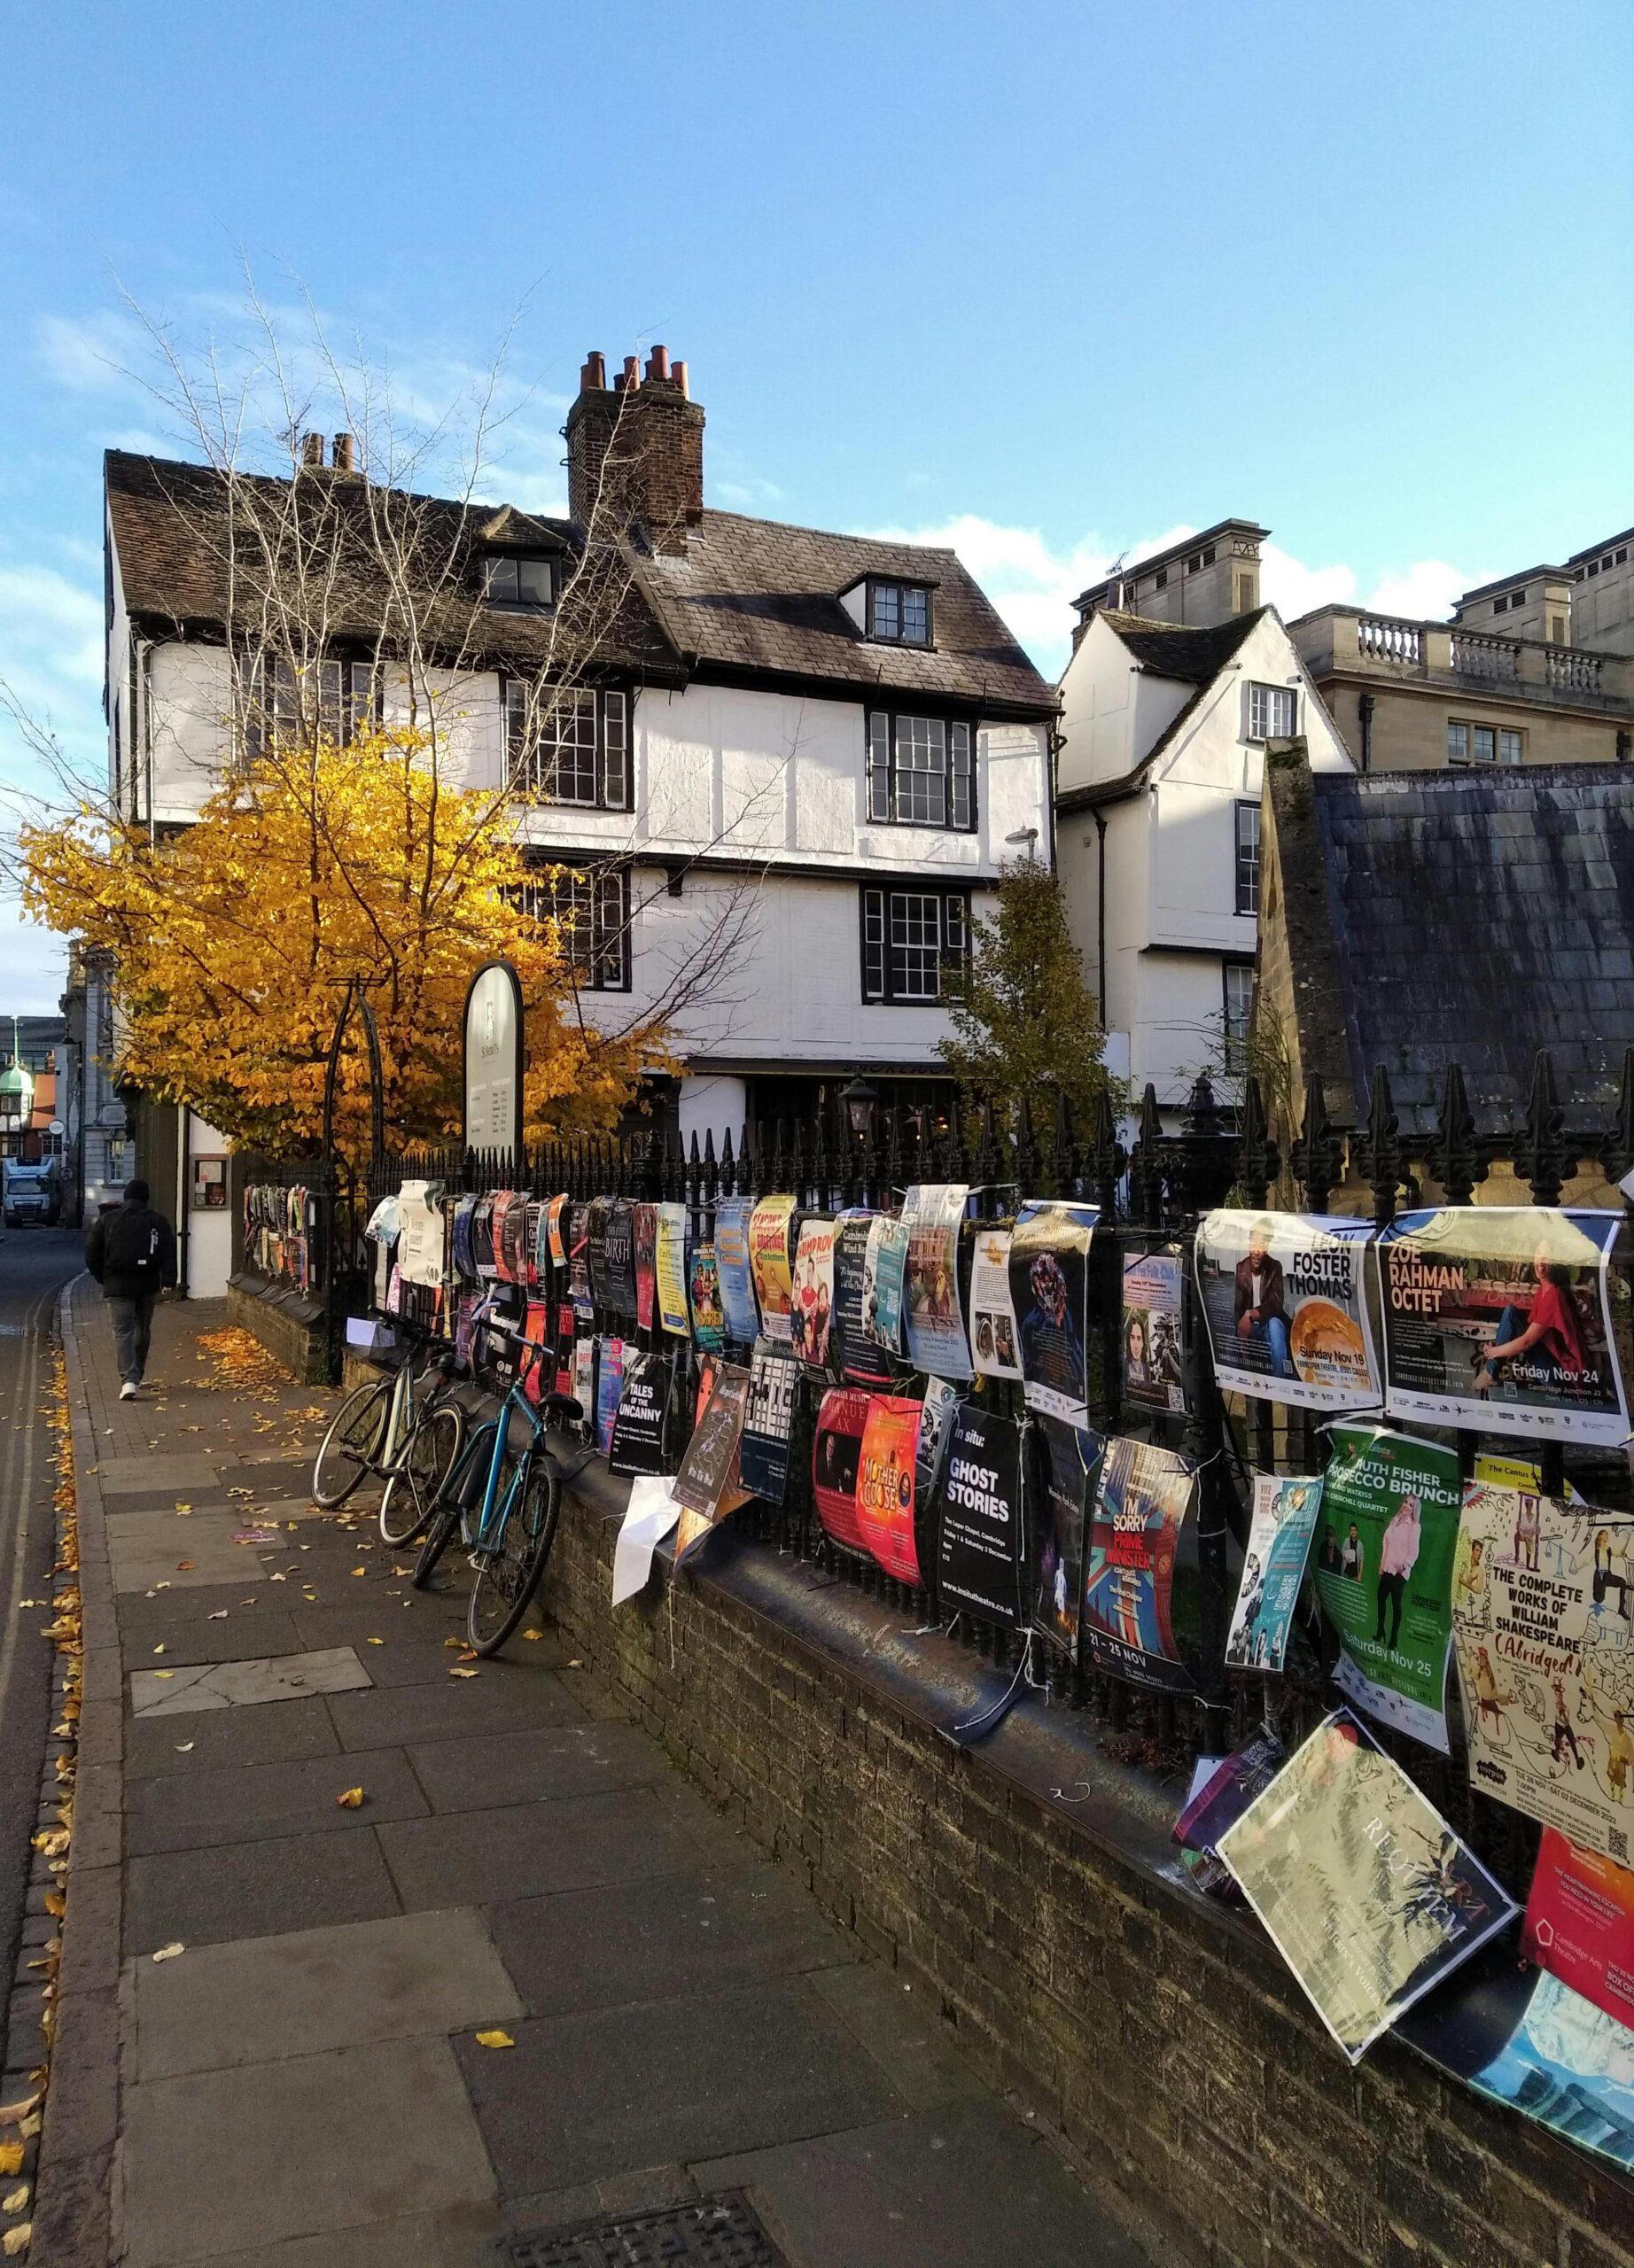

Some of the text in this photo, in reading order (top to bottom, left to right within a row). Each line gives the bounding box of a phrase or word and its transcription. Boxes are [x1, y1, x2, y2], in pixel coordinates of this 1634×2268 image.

[604, 1238, 631, 1263] BIRTH
[1293, 1252, 1351, 1278] FOSTER
[1389, 1263, 1464, 1290] RAHMAN
[1286, 1273, 1353, 1301] THOMAS
[1391, 1286, 1443, 1313] OCTET
[1300, 1346, 1365, 1365] Sunday Nov 19
[1512, 1363, 1599, 1383] Friday Nov 24
[630, 1383, 653, 1398] TALES
[1528, 1383, 1562, 1394] Cambridge
[1563, 1387, 1592, 1396] Junction
[619, 1402, 662, 1422] UNCANNY
[637, 1398, 648, 1407] THE
[836, 1418, 851, 1433] AX
[954, 1427, 964, 1440] in
[863, 1456, 899, 1487] MOTHER
[949, 1456, 999, 1493] GHOST
[1392, 1466, 1441, 1487] FISHER
[1488, 1464, 1502, 1473] The
[1504, 1467, 1529, 1479] Cantus
[862, 1480, 899, 1511] GOOSE
[1327, 1464, 1386, 1489] PROSECCO
[1389, 1479, 1459, 1505] BRUNCH
[1346, 1487, 1373, 1499] WATKISS
[946, 1480, 1009, 1522] STORIES
[1123, 1495, 1140, 1515] I'M
[1357, 1501, 1389, 1513] QUARTET
[1113, 1514, 1148, 1532] SORRY
[944, 1528, 957, 1540] Friday
[964, 1537, 984, 1552] Saturday
[988, 1548, 1012, 1562] December
[981, 1531, 1006, 1547] Cambridge
[1114, 1531, 1143, 1550] PRIME
[1106, 1546, 1151, 1569] MINISTER
[1493, 1565, 1583, 1604] THE COMPLETE
[942, 1580, 1014, 1617] www.insitutheatre.co.uk
[1508, 1587, 1568, 1615] WORKS OF
[1512, 1604, 1559, 1631] WILLIAM
[1496, 1616, 1581, 1654] SHAKESPEARE
[1089, 1633, 1099, 1647] 21
[1109, 1642, 1121, 1657] 25
[1123, 1649, 1147, 1667] NOV
[1342, 1628, 1389, 1661] Saturday
[1391, 1650, 1414, 1671] Nov
[1418, 1660, 1432, 1677] 25
[1495, 1633, 1582, 1678] (Abridged!)
[1480, 1765, 1504, 1781] corpus
[1516, 1770, 1526, 1780] TUE
[1535, 1779, 1545, 1790] NOV
[1550, 1786, 1560, 1797] SAT
[1560, 1792, 1569, 1801] 02
[1569, 1796, 1599, 1817] DECEMBER
[1601, 1812, 1616, 1825] 2023
[1553, 1865, 1564, 1876] THE
[1563, 1873, 1601, 1901] HEARTWARMING
[1601, 1897, 1626, 1916] ESCAPISM
[1560, 1880, 1570, 1891] YOU
[1570, 1887, 1583, 1899] NEED
[1590, 1899, 1604, 1912] YOUR
[1553, 1941, 1576, 1964] Theatre
[1555, 1932, 1602, 1971] Cambridge Arts
[1607, 1960, 1620, 1972] THU
[1607, 1971, 1622, 1987] BOX
